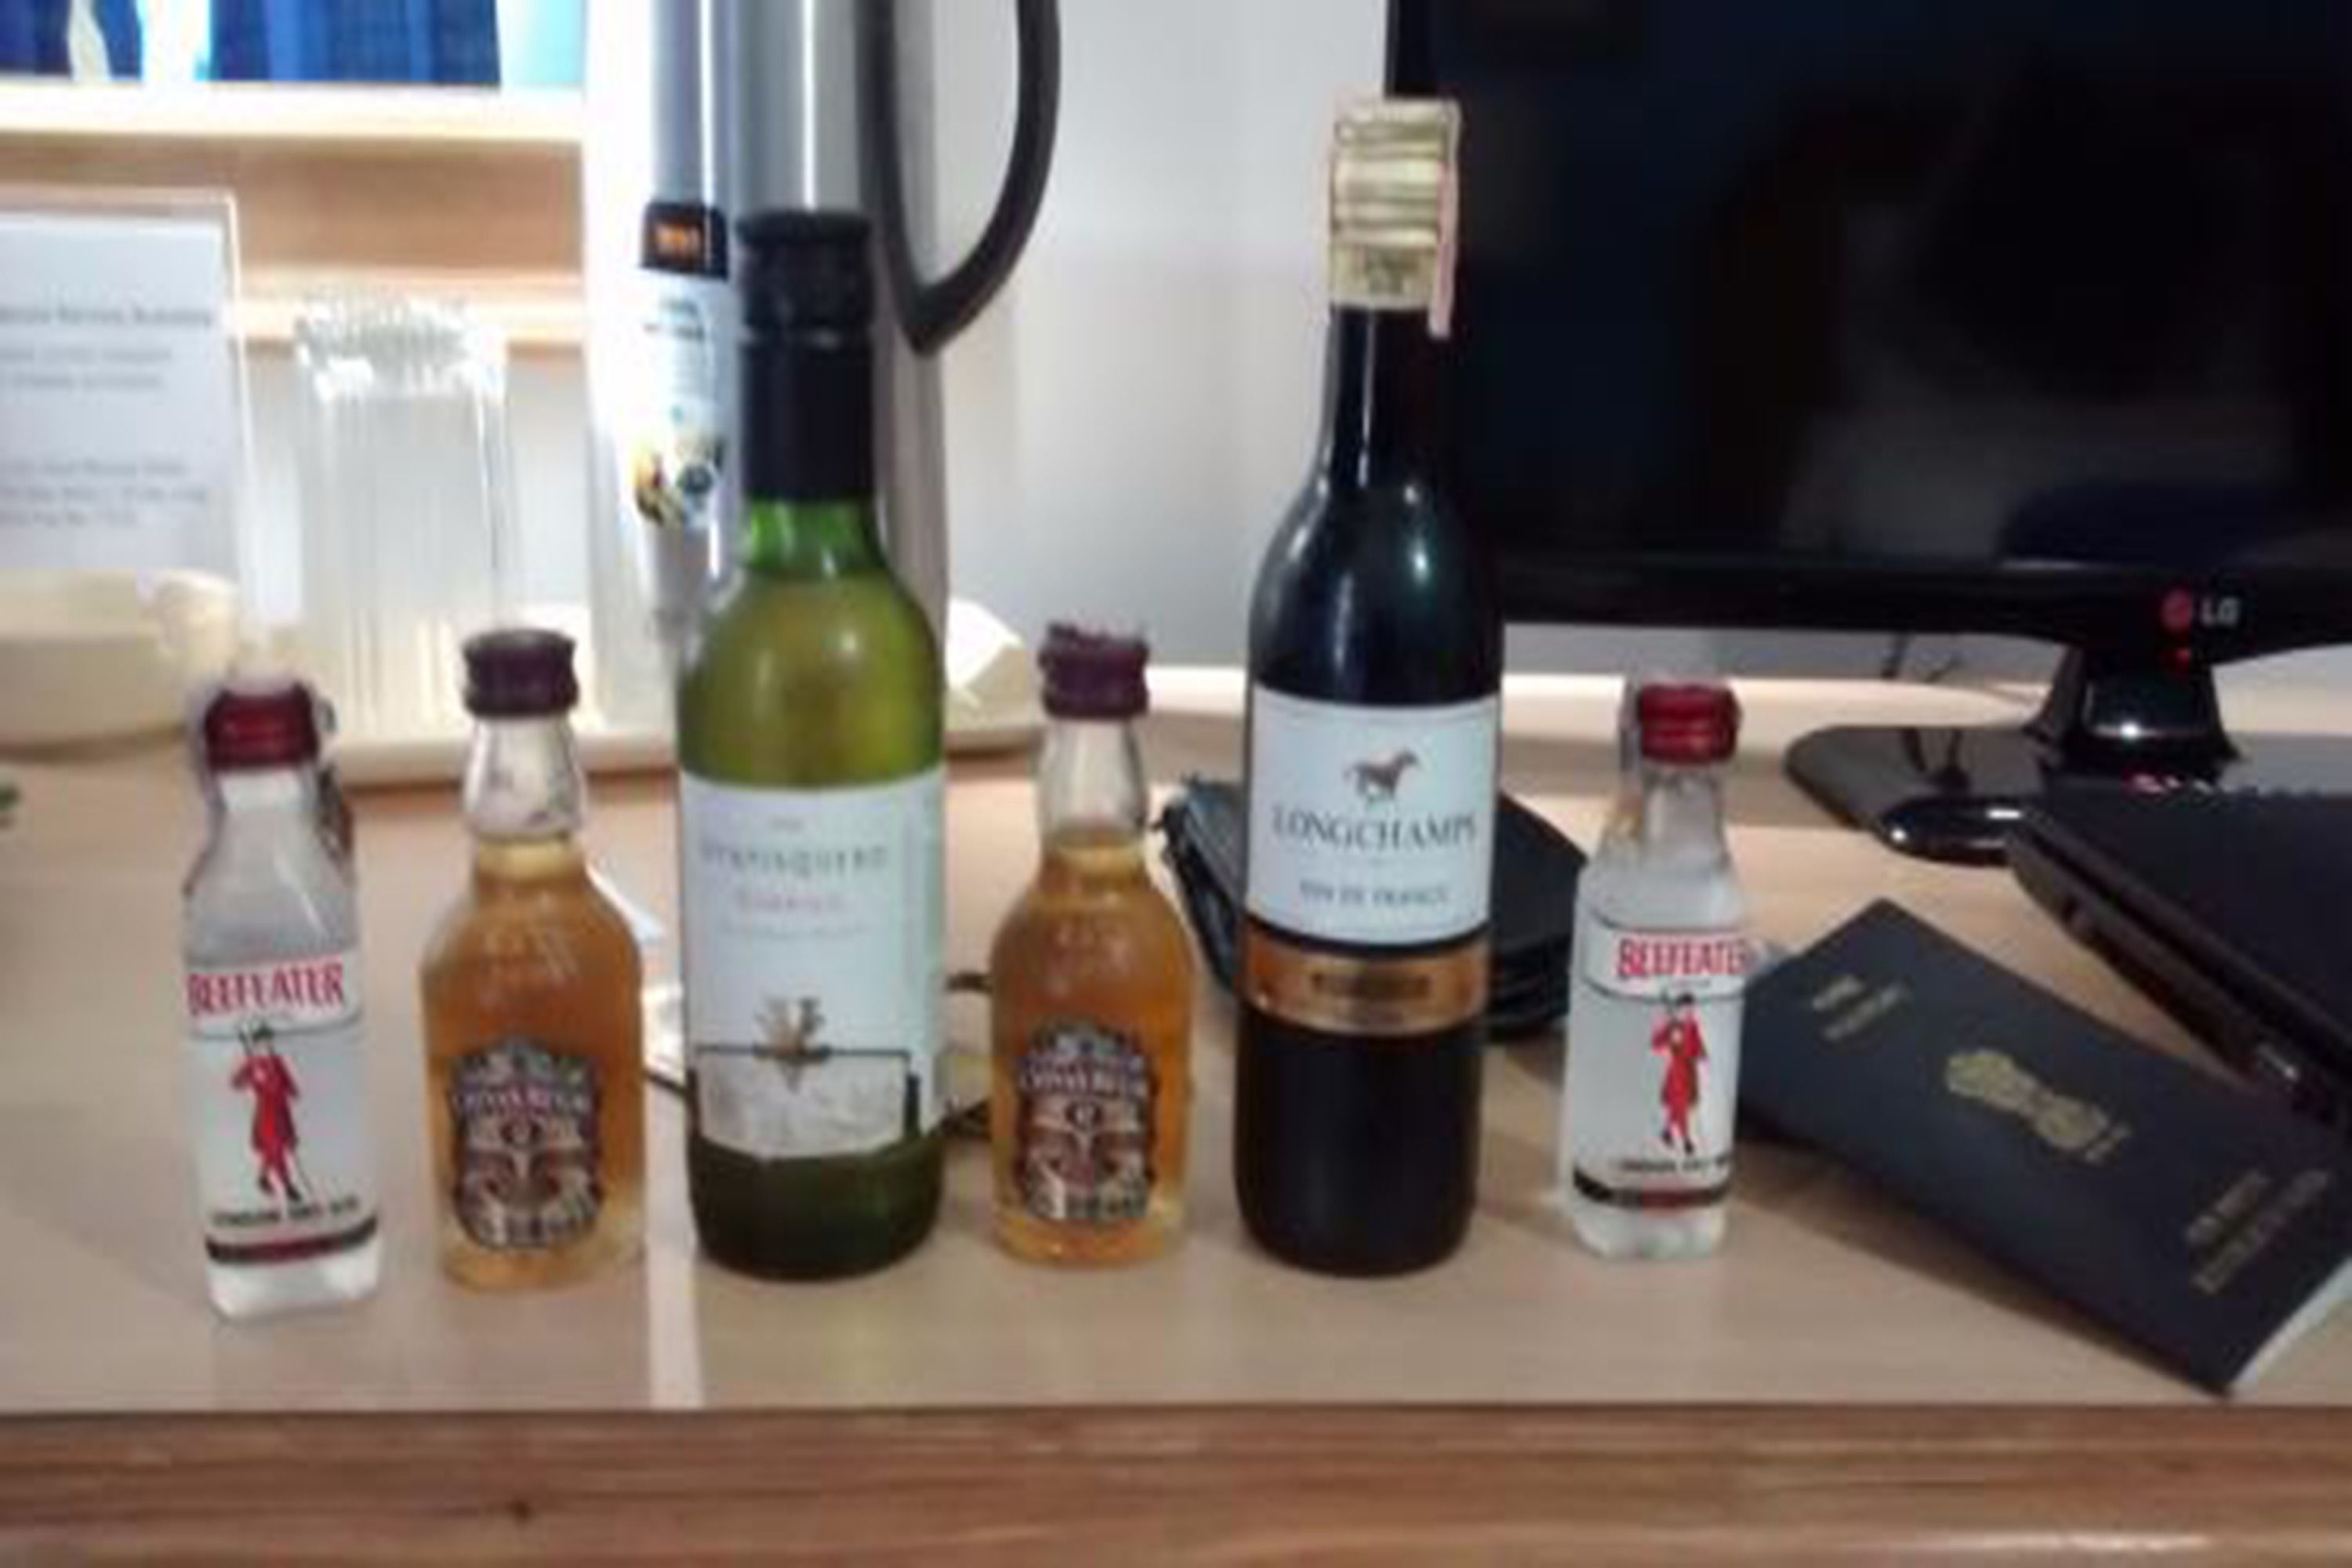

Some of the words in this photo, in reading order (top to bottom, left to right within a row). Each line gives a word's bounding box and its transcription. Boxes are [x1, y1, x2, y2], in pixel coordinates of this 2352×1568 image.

[2200, 597, 2241, 627] LG
[1618, 937, 1750, 979] BEEFEATER
[187, 963, 344, 1017] BEEFEATER
